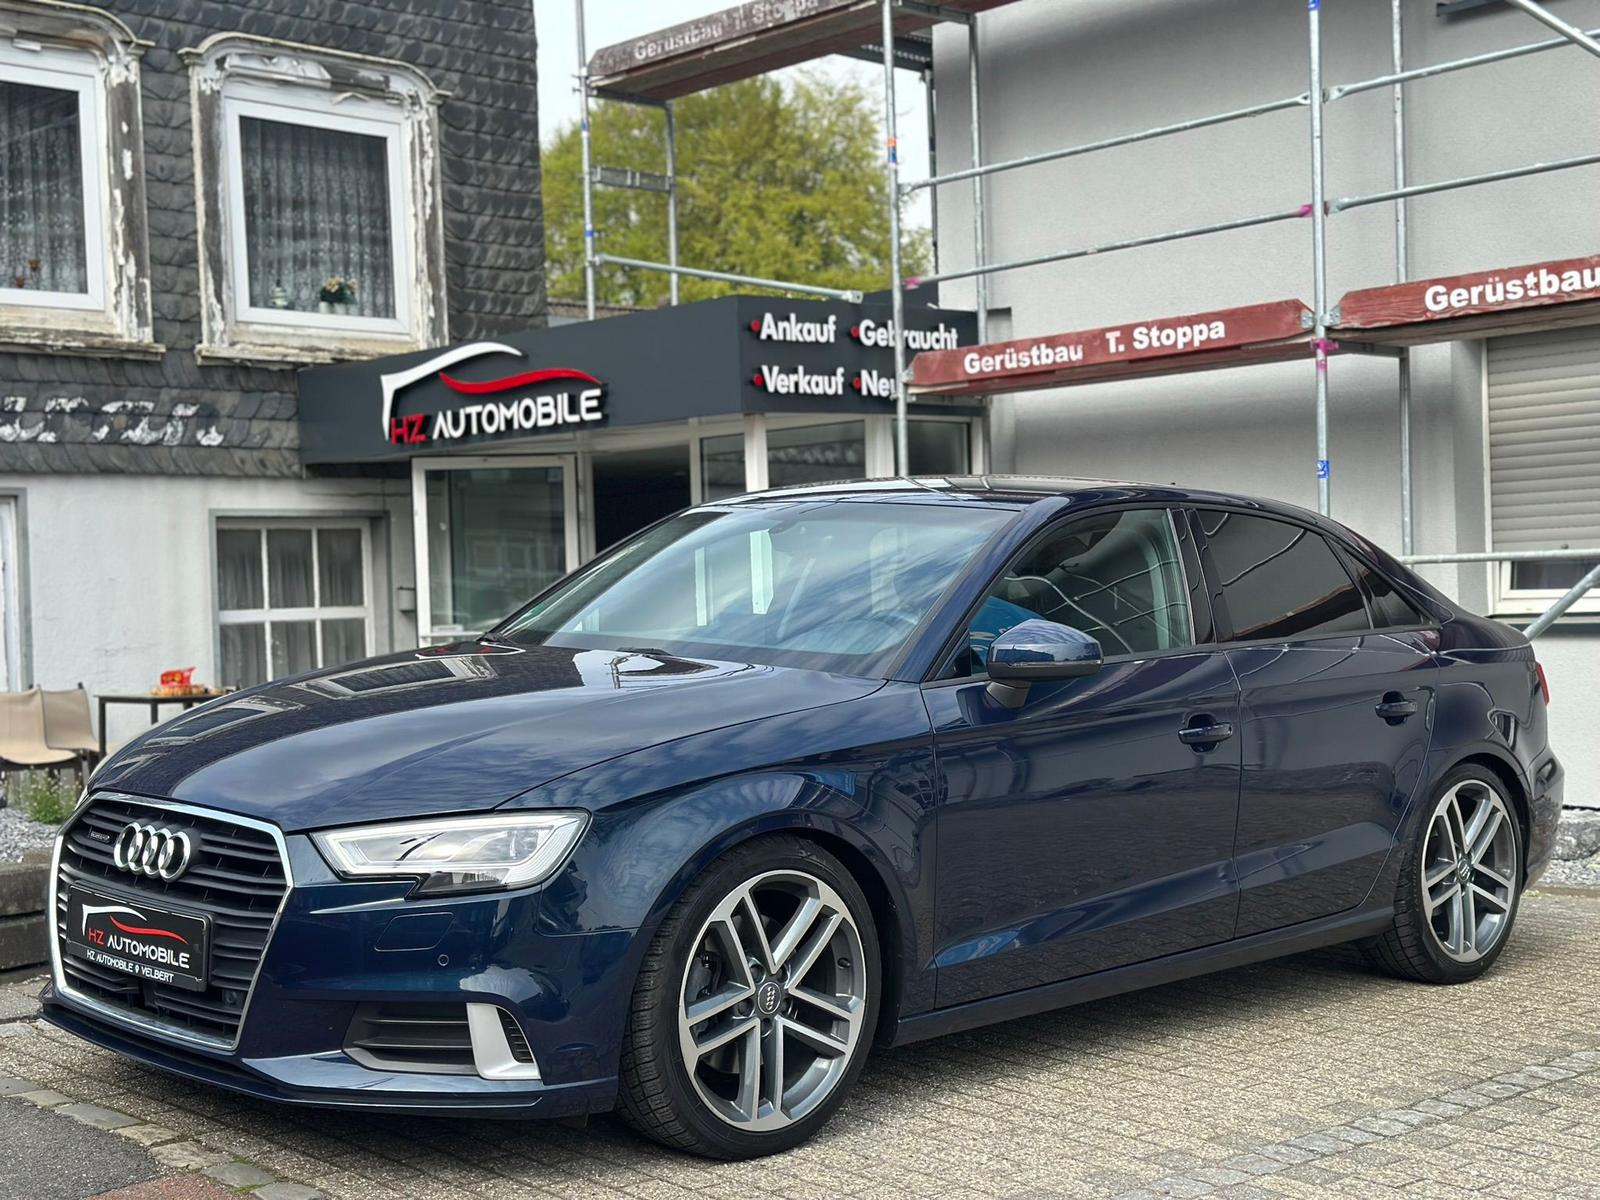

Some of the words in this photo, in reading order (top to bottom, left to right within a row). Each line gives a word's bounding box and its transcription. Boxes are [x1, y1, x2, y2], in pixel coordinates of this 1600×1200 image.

[1424, 267, 1600, 311] Gerüstbau
[760, 312, 837, 343] Ankauf
[963, 344, 1083, 374] Gerüstbau
[1105, 331, 1125, 355] T.
[1133, 320, 1226, 352] Stoppa
[762, 364, 844, 395] Verkauf
[391, 413, 427, 444] HZ
[432, 388, 602, 439] AUTOMOBILE
[86, 949, 96, 961] HZ
[96, 955, 134, 973] AUTOMOBILE
[141, 966, 174, 983] VELBERT
[88, 927, 105, 945] HZ
[107, 935, 190, 968] AUTOMOBILE
